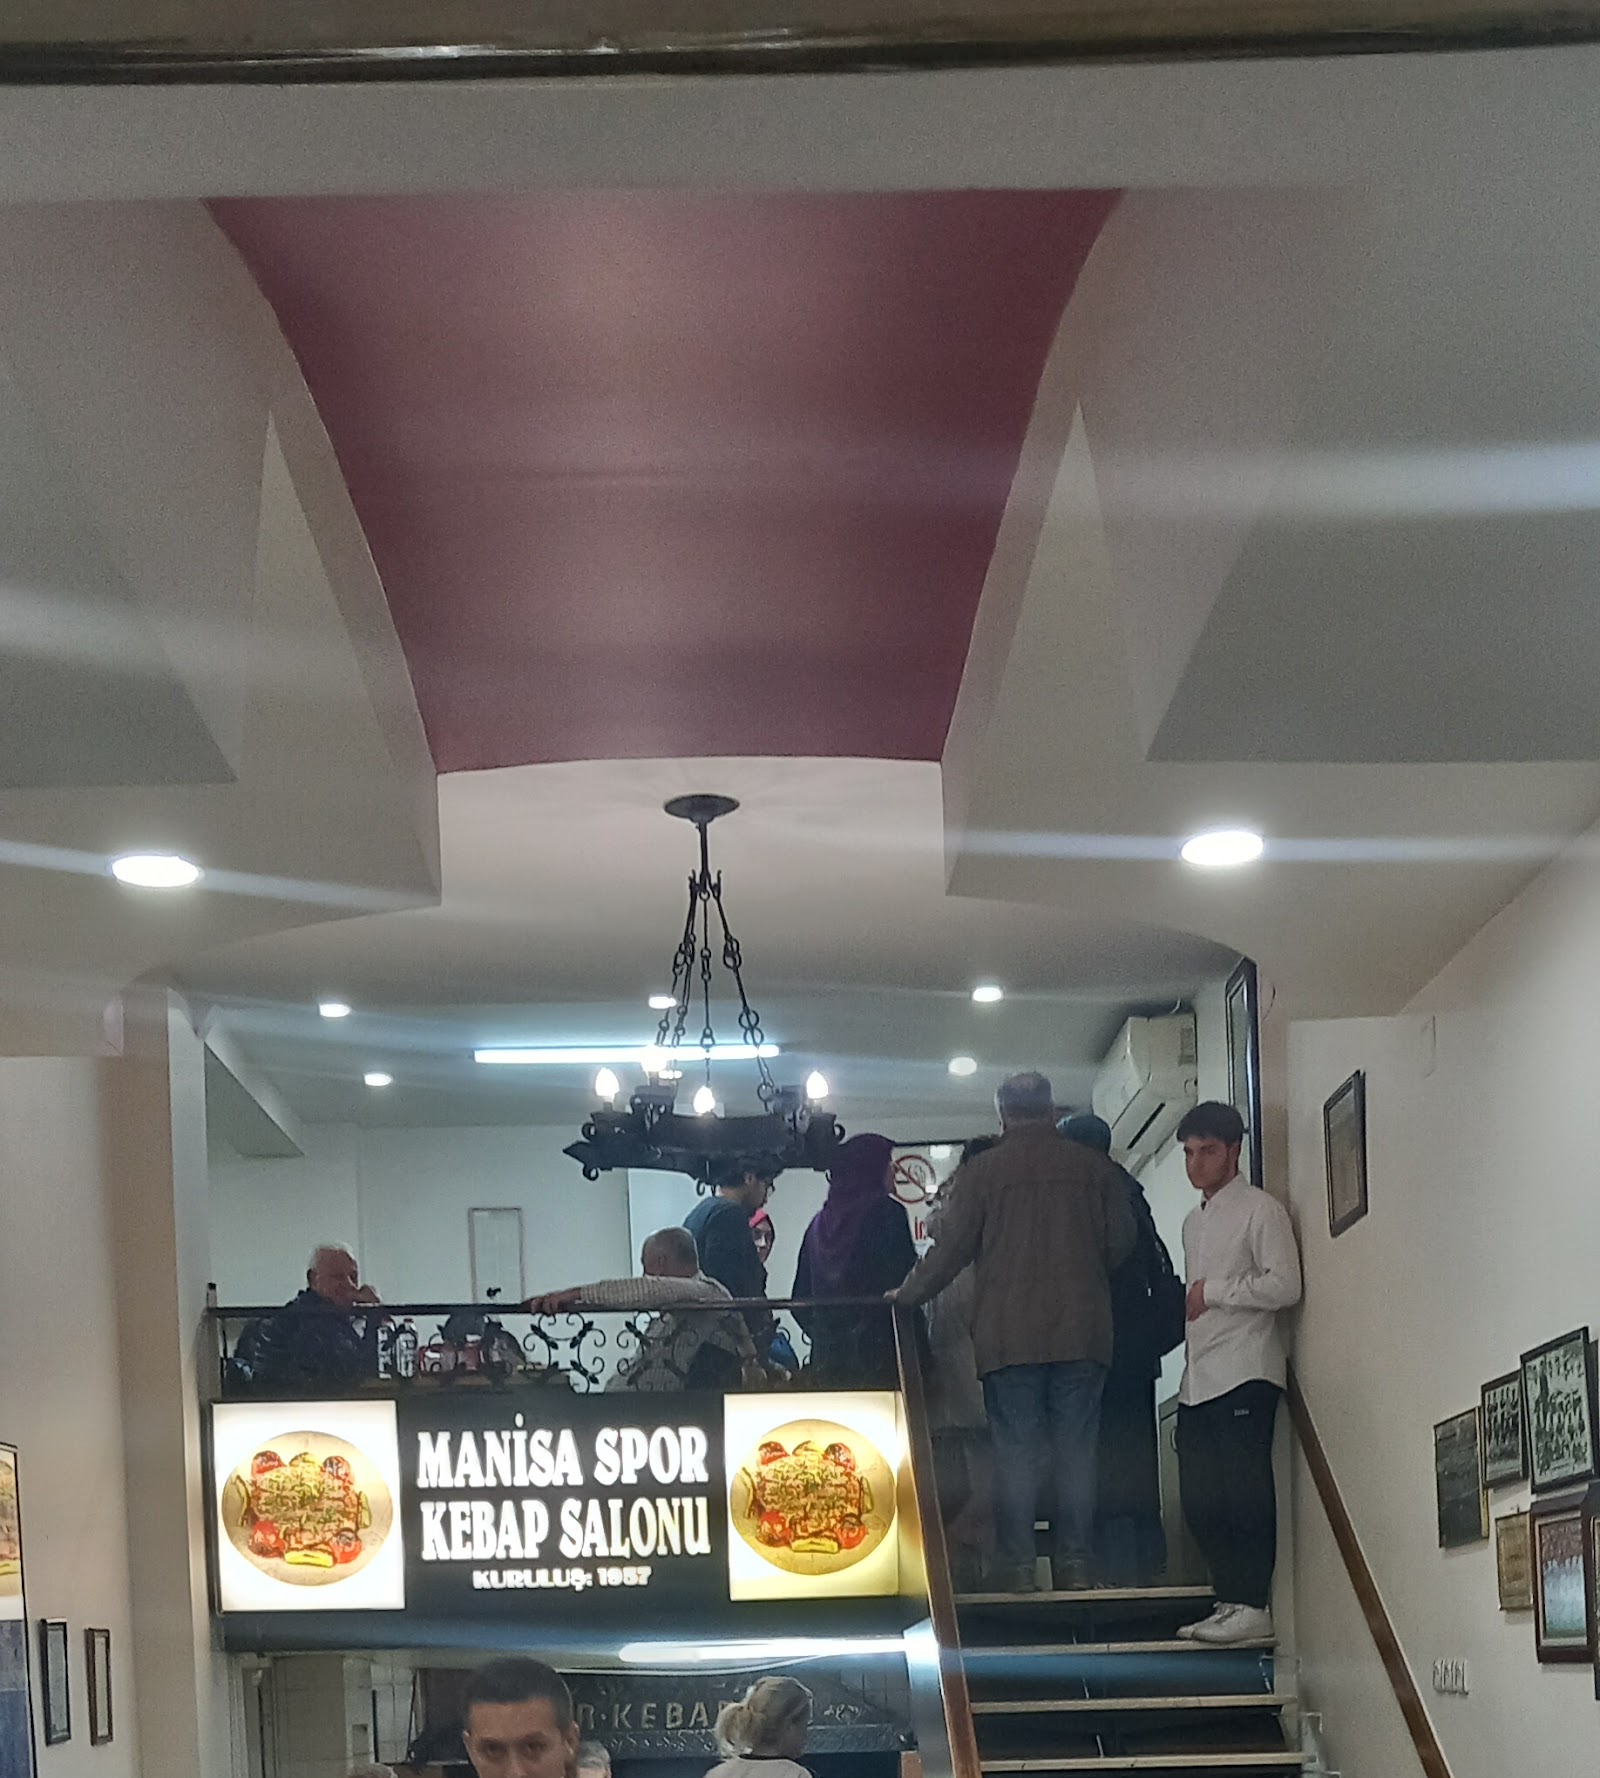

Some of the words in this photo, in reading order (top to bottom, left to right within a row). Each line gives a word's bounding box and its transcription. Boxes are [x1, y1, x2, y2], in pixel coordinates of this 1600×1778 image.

[416, 1412, 584, 1488] MANİSA
[593, 1425, 709, 1486] SPOR
[420, 1499, 550, 1561] KEBAP
[558, 1496, 711, 1559] SALONU
